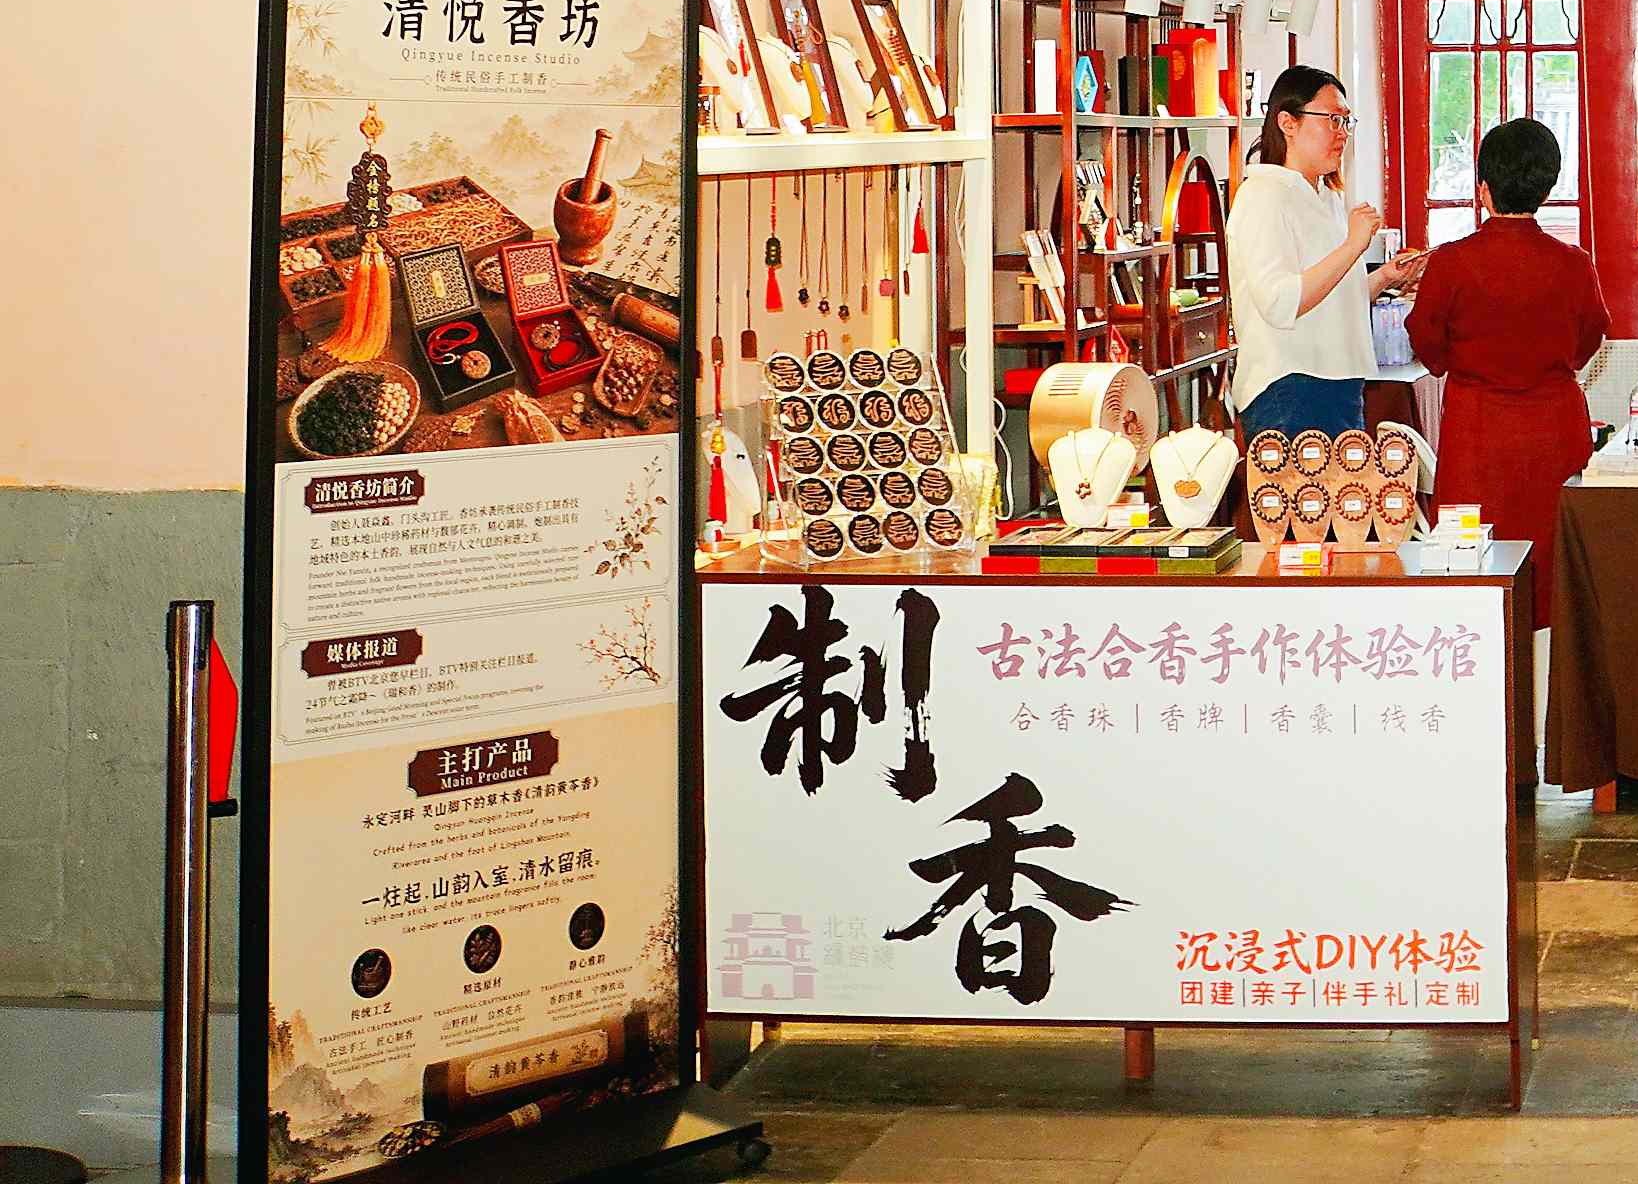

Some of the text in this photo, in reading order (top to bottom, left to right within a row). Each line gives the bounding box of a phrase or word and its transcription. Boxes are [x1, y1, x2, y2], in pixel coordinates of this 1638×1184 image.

[401, 47, 580, 65] Qingyue Incense Studio
[435, 69, 548, 86] 传统民俗手工制香
[314, 474, 415, 502] 清悦香坊简介
[326, 635, 398, 664] 媒体报道
[976, 622, 1481, 686] 古法合香手作体验馆
[1009, 703, 1448, 735] 合香珠 香牌 香囊 线香
[435, 736, 532, 776] 主打产品
[440, 763, 528, 790] Main Product
[720, 584, 1140, 1006] 制香
[362, 806, 415, 829] 永定河畔
[1176, 928, 1484, 974] 沉浸式DIY体验
[1180, 980, 1480, 1007] 团建 亲子 伴手礼 定制
